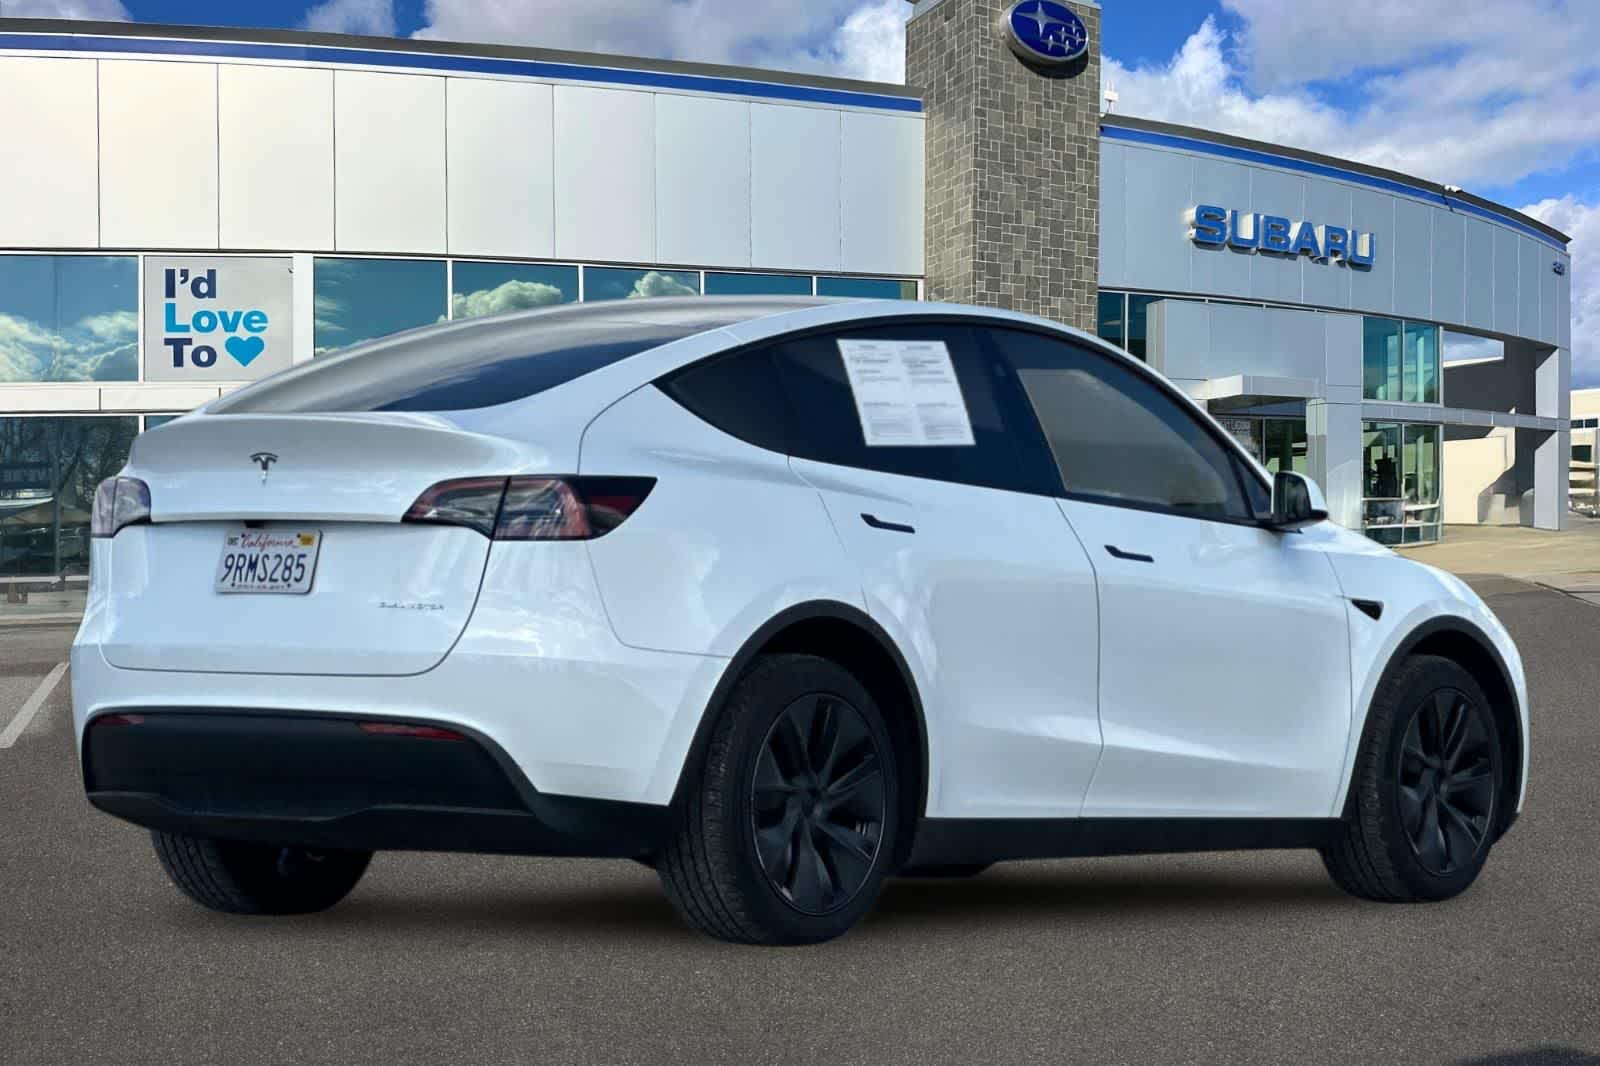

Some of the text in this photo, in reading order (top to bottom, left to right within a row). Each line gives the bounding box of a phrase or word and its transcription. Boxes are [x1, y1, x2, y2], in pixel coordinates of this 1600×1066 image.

[1192, 204, 1376, 268] SUBARU
[164, 268, 217, 299] I’d
[164, 302, 269, 333] Love
[163, 337, 218, 368] To
[241, 533, 298, 552] California
[221, 553, 307, 582] 9RMS285
